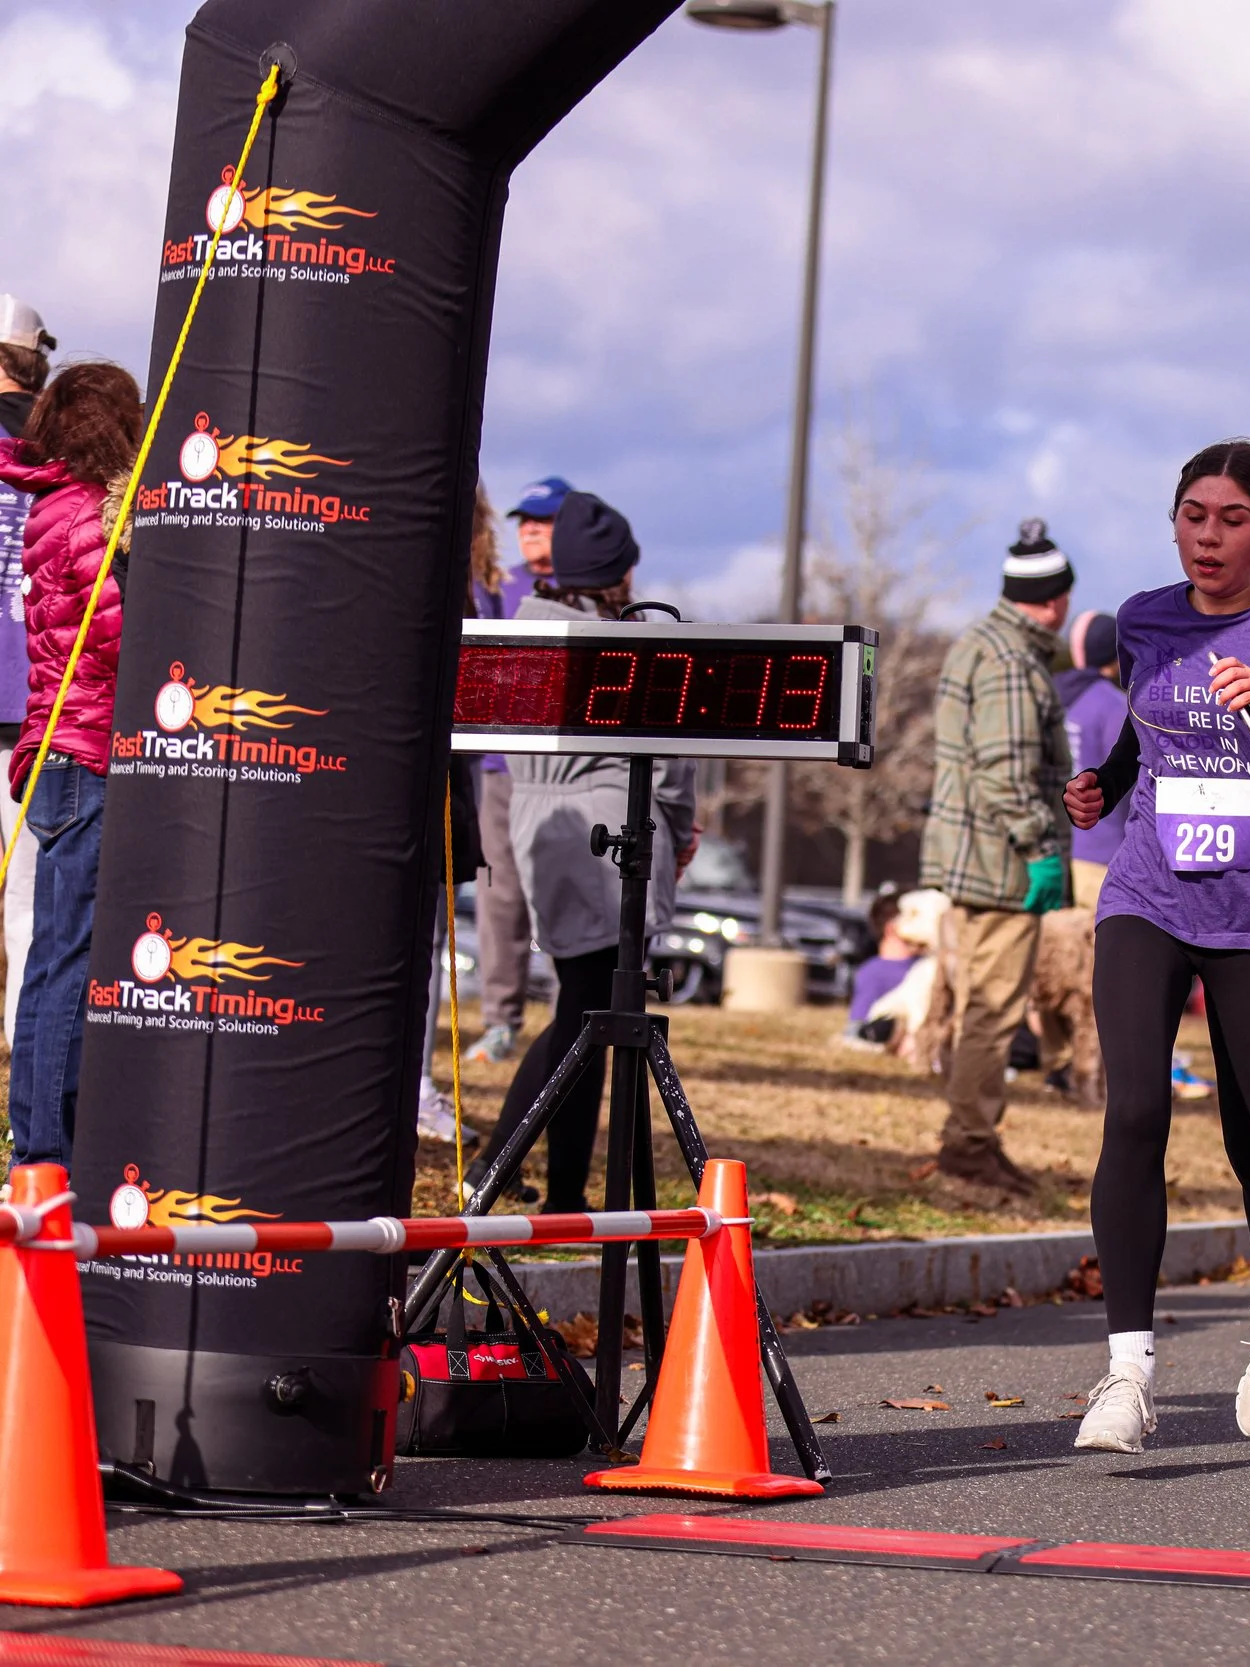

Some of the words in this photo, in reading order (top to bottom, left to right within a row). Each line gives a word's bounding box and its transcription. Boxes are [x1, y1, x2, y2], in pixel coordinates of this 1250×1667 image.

[187, 265, 216, 280] Timg
[218, 263, 238, 277] and
[241, 264, 286, 281] Scoring
[290, 266, 350, 284] Solutions
[160, 511, 189, 528] Timing
[192, 512, 212, 527] and
[215, 513, 260, 530] Scoring
[265, 515, 325, 533] Solutions
[585, 652, 827, 729] 27:13
[1216, 714, 1236, 731] IS
[1220, 736, 1239, 754] IN
[136, 761, 165, 778] Timing
[168, 761, 188, 776] and
[191, 763, 237, 781] Scoring
[241, 766, 302, 784] Solutions
[1163, 754, 1198, 771] THE
[1175, 822, 1235, 863] 229
[113, 1010, 142, 1029] Timing
[145, 1012, 166, 1028] and
[168, 1015, 214, 1033] Scoring
[218, 1018, 279, 1035] Solutions
[91, 1260, 121, 1279] Timing
[123, 1266, 144, 1281] and
[147, 1267, 193, 1286] Scoring
[196, 1271, 257, 1288] Solutions
